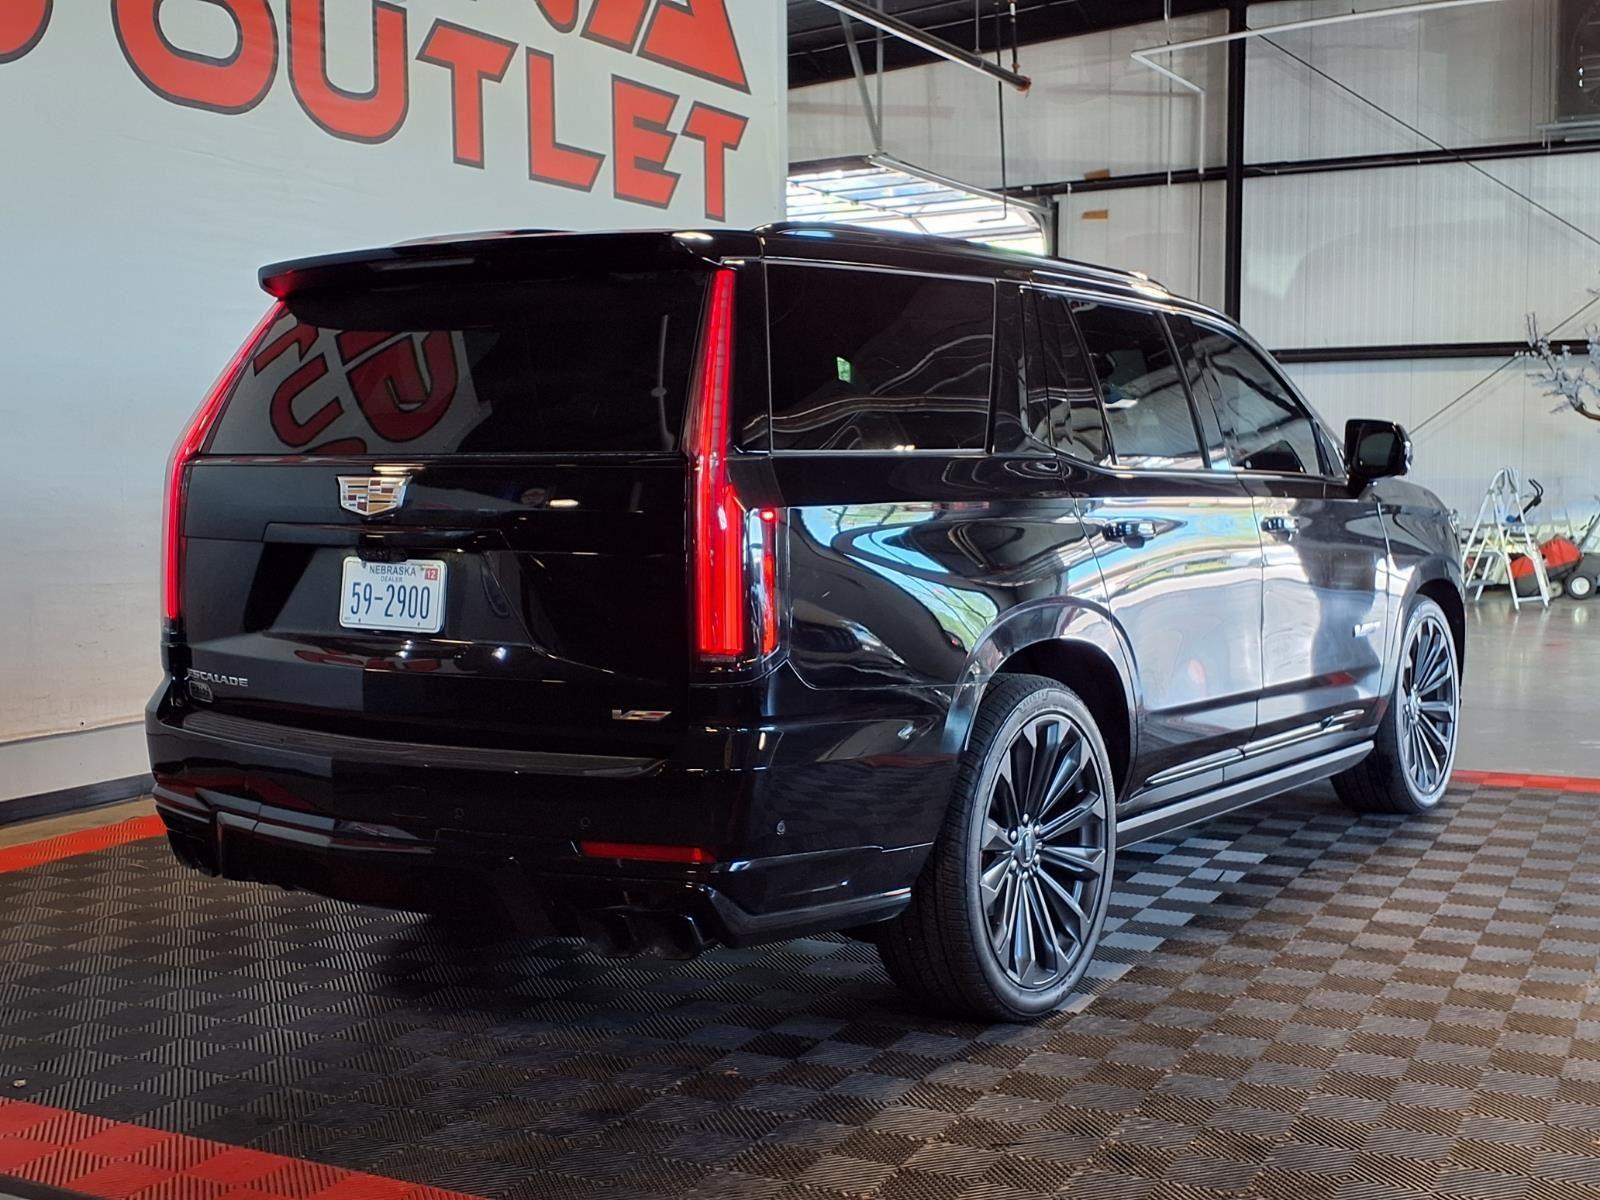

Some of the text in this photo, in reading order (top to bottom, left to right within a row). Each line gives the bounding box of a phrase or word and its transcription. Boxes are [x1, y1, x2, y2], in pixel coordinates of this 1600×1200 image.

[112, 0, 750, 222] OUTLET
[369, 565, 417, 576] NEBRASKA
[426, 569, 437, 579] 12
[350, 582, 431, 620] 59-2900
